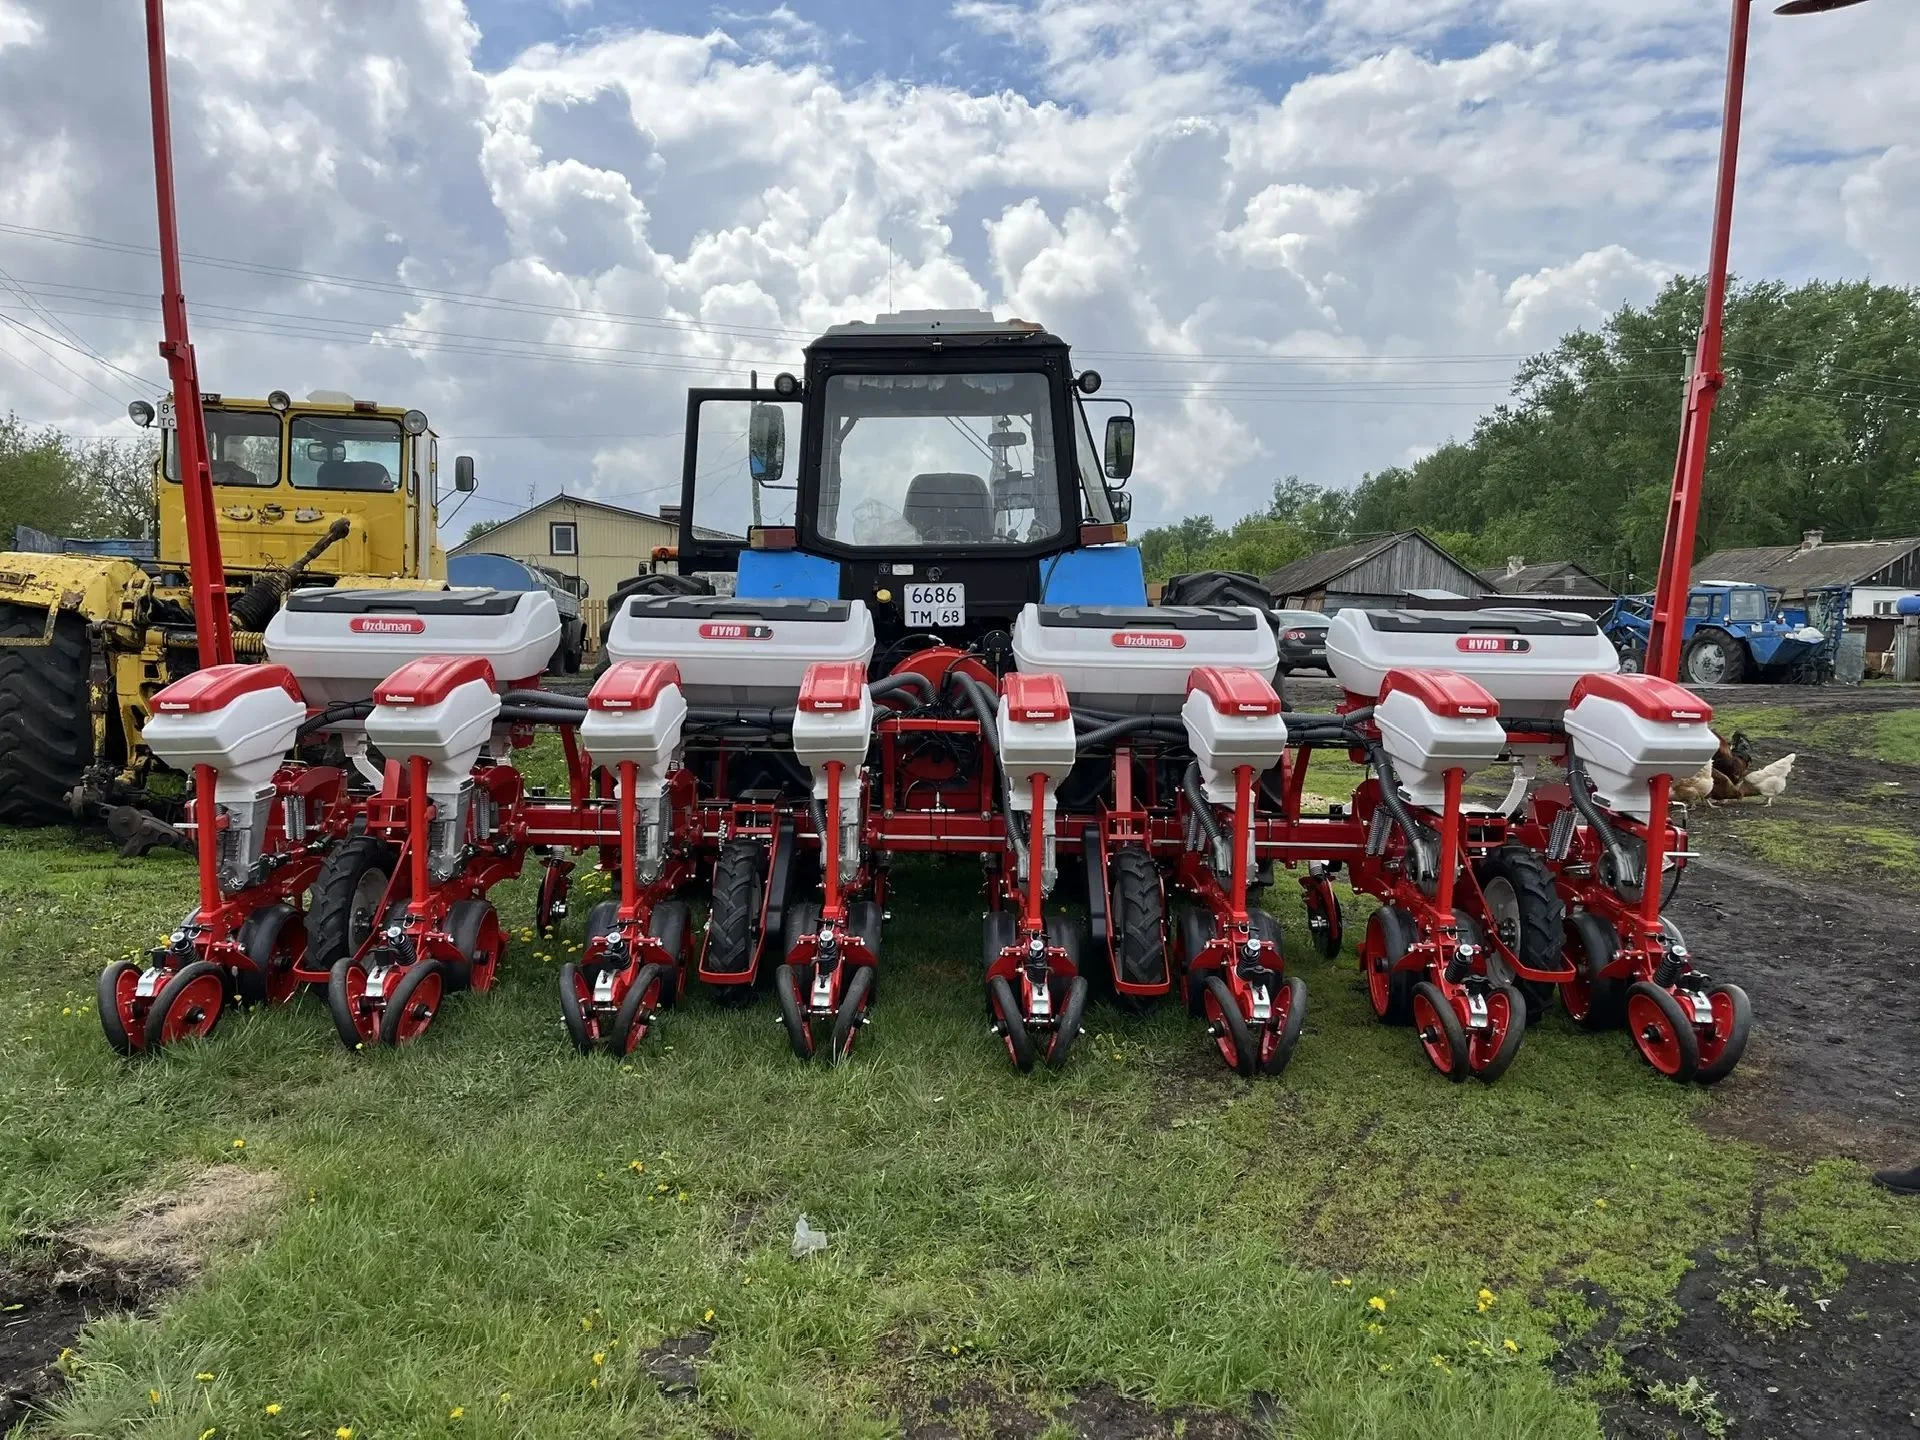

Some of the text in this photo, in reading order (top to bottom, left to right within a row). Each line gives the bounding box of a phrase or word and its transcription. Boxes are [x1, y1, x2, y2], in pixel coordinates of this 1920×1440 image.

[912, 587, 957, 604] 6686
[941, 610, 960, 623] 68
[754, 627, 762, 637] 8
[1512, 640, 1519, 650] 8
